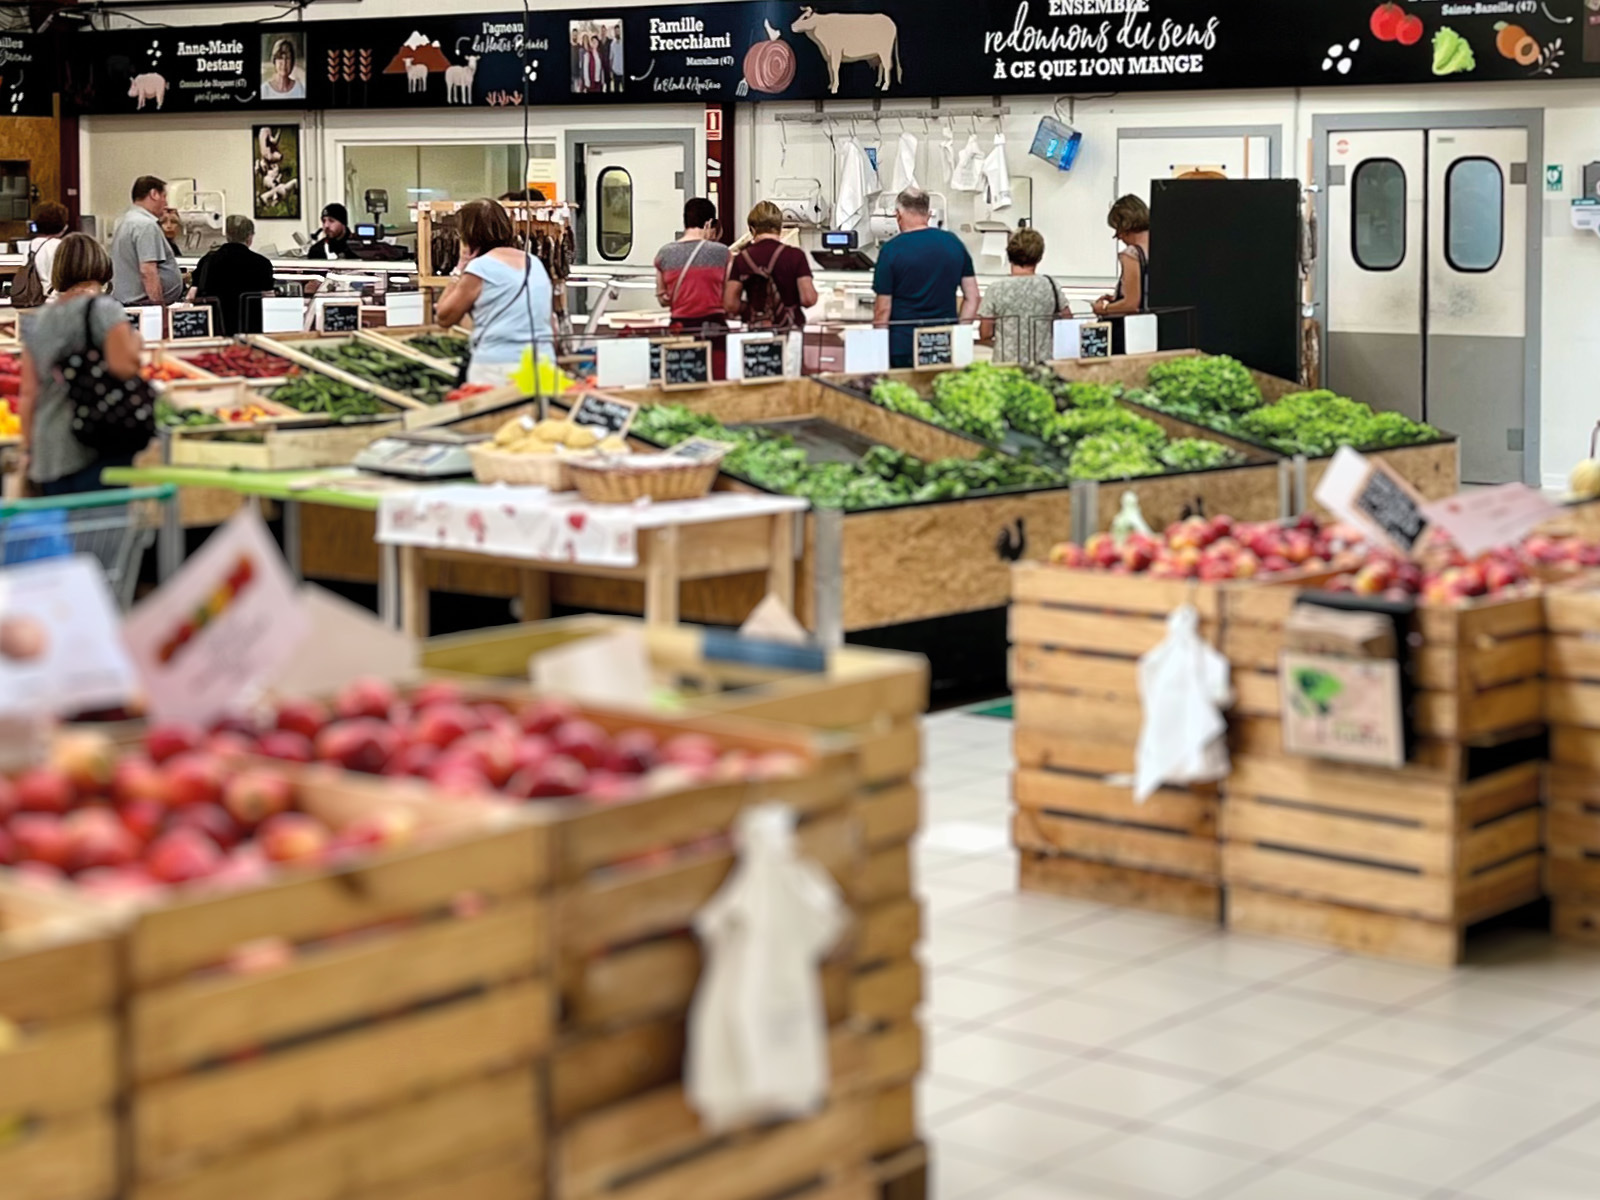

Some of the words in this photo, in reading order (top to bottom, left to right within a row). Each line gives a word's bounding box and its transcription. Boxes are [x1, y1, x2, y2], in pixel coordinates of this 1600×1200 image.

[1515, 1, 1537, 13] (47)
[649, 17, 704, 34] Famille
[984, 1, 1111, 54] redonnons
[1115, 9, 1155, 49] du
[1158, 16, 1220, 51] sens
[177, 39, 243, 56] Anne-Marie
[196, 57, 243, 75] Destang
[993, 58, 1007, 79] À
[1010, 61, 1036, 78] CE
[1039, 60, 1077, 81] QUE
[1079, 57, 1124, 76] L'ON
[1127, 54, 1204, 75] MANGE
